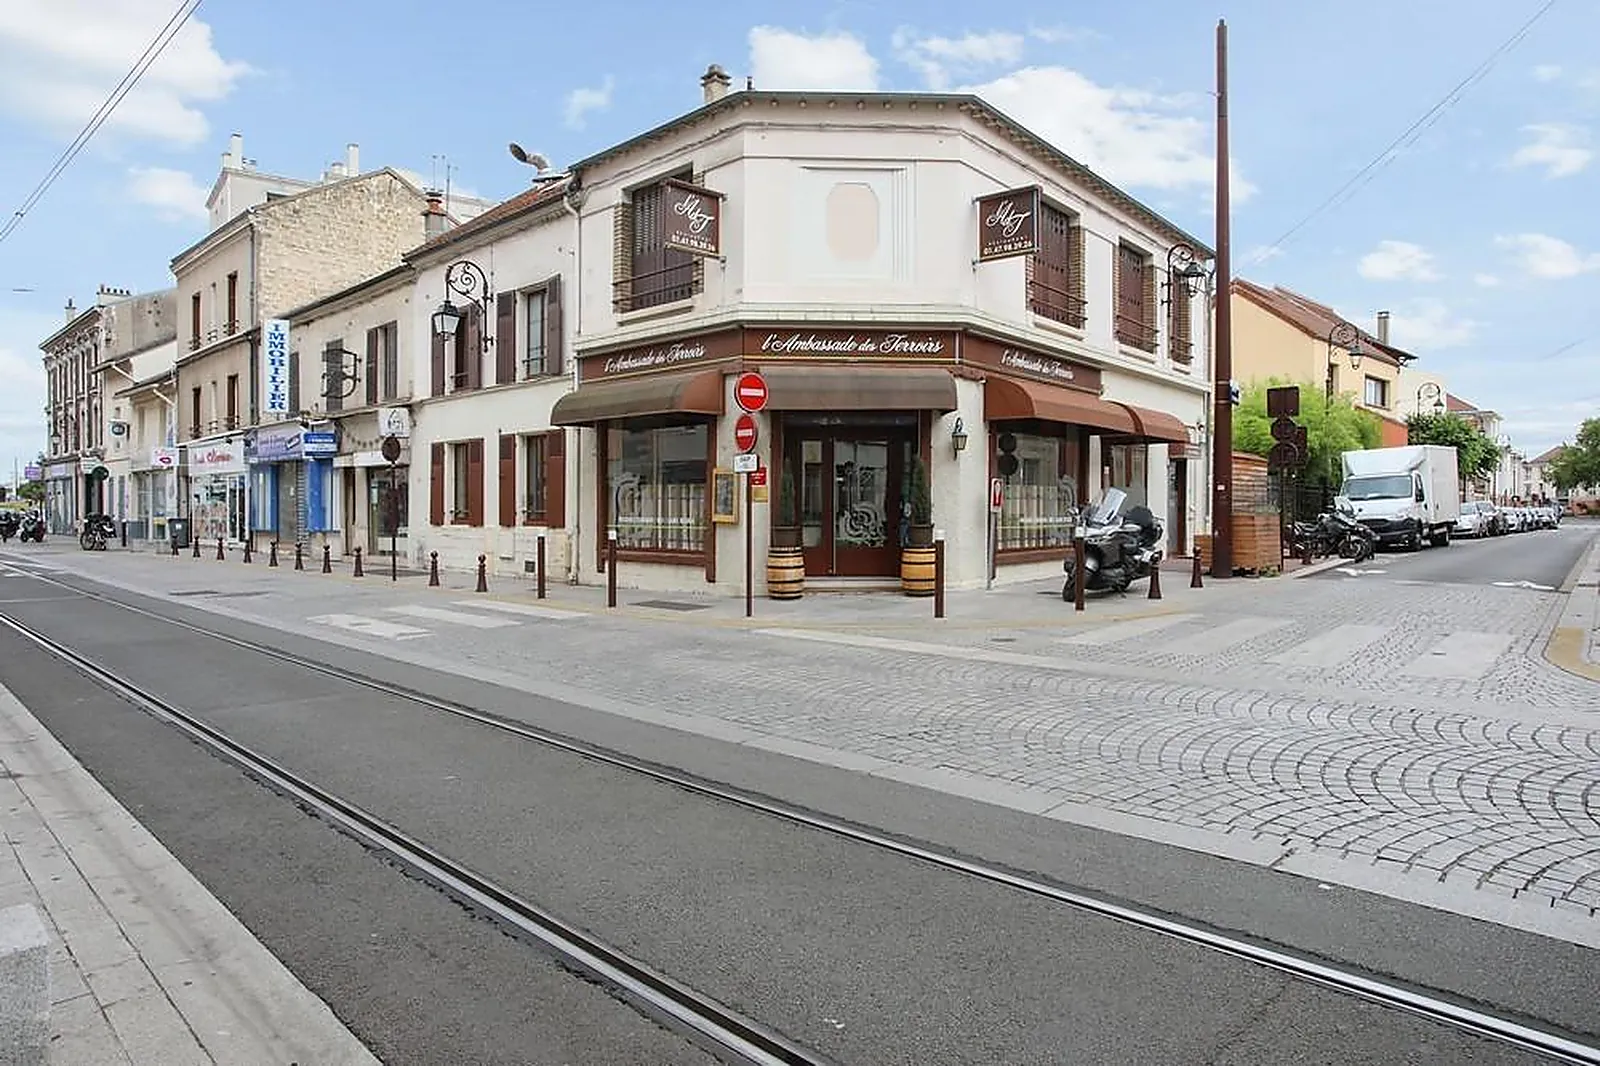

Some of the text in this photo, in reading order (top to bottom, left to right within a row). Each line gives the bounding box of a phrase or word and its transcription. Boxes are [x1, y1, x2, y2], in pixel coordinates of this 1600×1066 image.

[268, 324, 286, 410] IMMOBILIER
[761, 334, 944, 353] l'Ambassade des Terroirs
